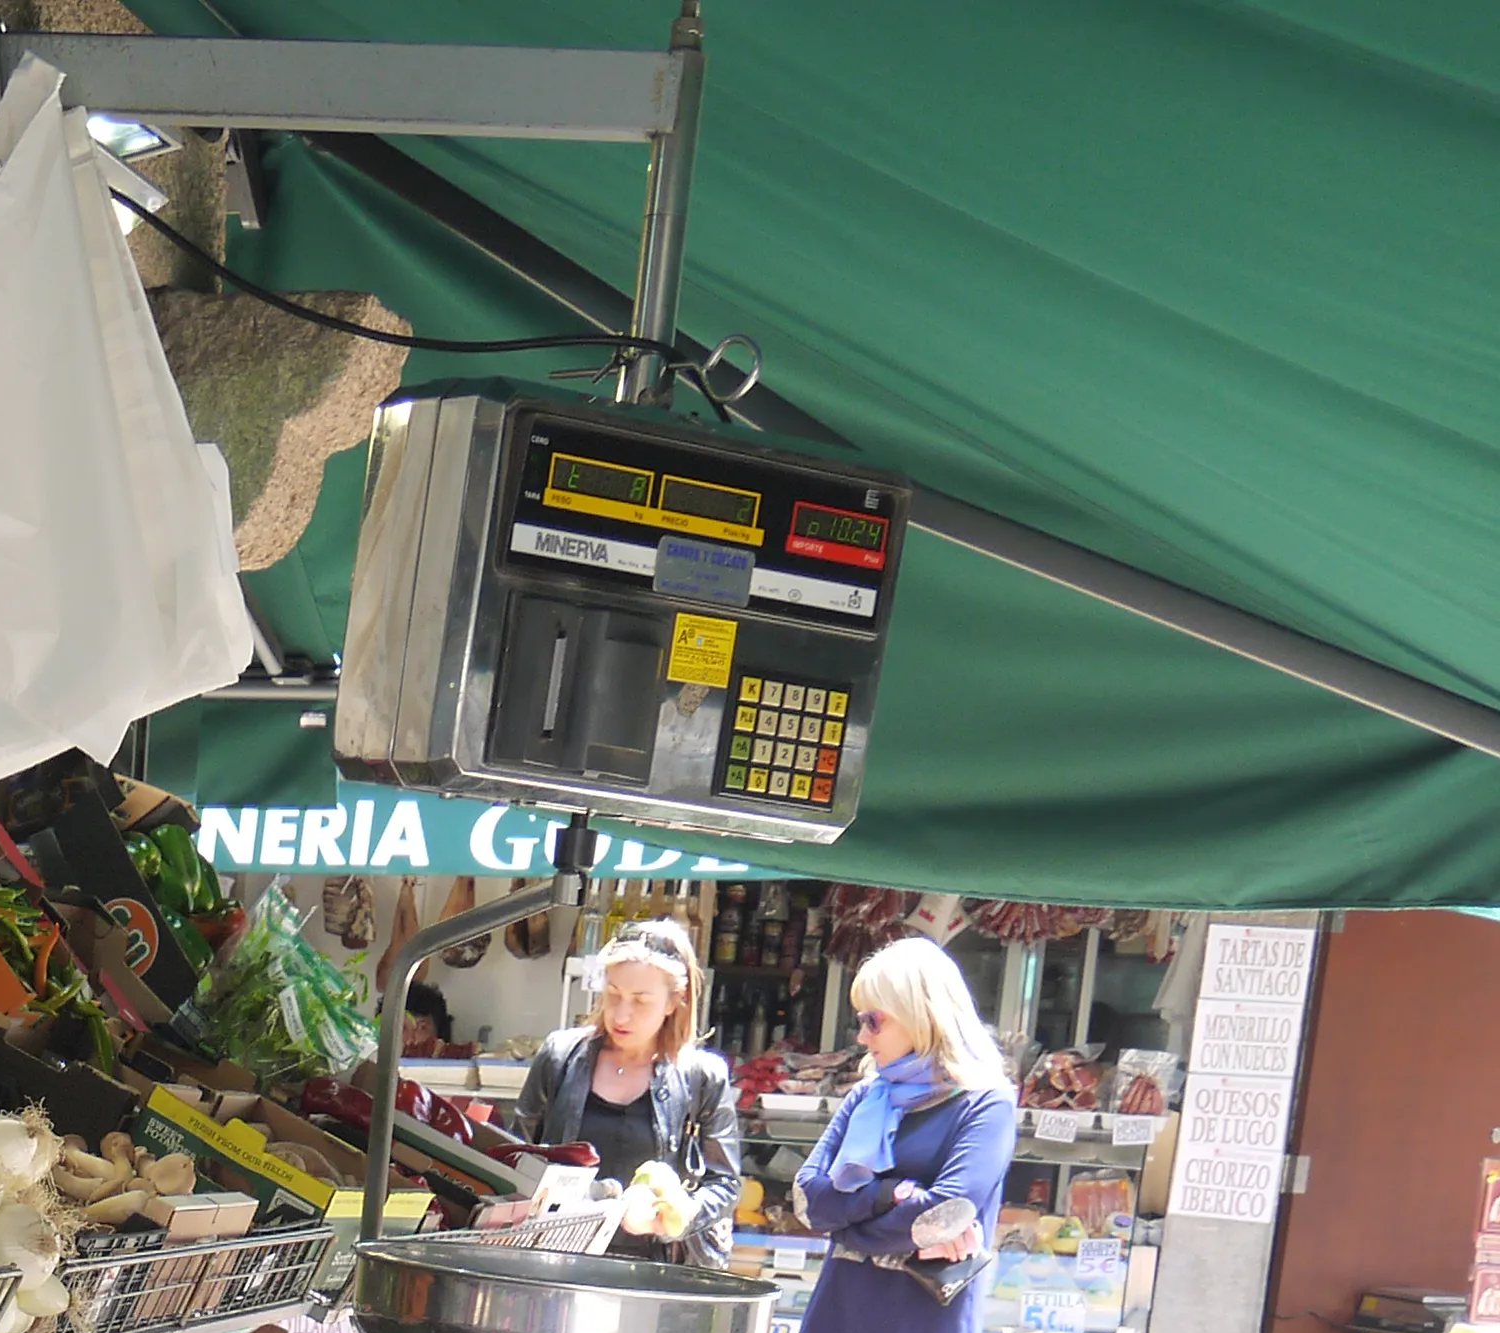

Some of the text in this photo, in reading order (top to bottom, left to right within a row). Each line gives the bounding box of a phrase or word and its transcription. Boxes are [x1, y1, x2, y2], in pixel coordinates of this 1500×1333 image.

[661, 513, 689, 528] PRECIO
[534, 531, 609, 565] MINERVA
[770, 686, 778, 698] 7
[791, 689, 800, 702] 8
[813, 692, 821, 705] 9
[764, 716, 773, 728] 4
[786, 719, 795, 732] 5
[808, 722, 816, 735] 6
[760, 745, 767, 757] 1
[781, 748, 789, 760] 2
[803, 751, 811, 764] 3
[1219, 938, 1306, 968] TARTAS DE
[1214, 968, 1300, 997] SANTIAGO
[1203, 1014, 1292, 1044] MENBRILLO
[1200, 1043, 1288, 1072] CON NUECES
[1195, 1088, 1282, 1119] QUESOS
[148, 1117, 185, 1144] SWEET
[1189, 1116, 1277, 1147] DE LUGO
[216, 1134, 242, 1157] FROM
[242, 1150, 261, 1167] OUR
[1184, 1158, 1271, 1190] CHORIZO
[1178, 1186, 1266, 1218] IBERICO
[1022, 1293, 1086, 1308] TETILLA
